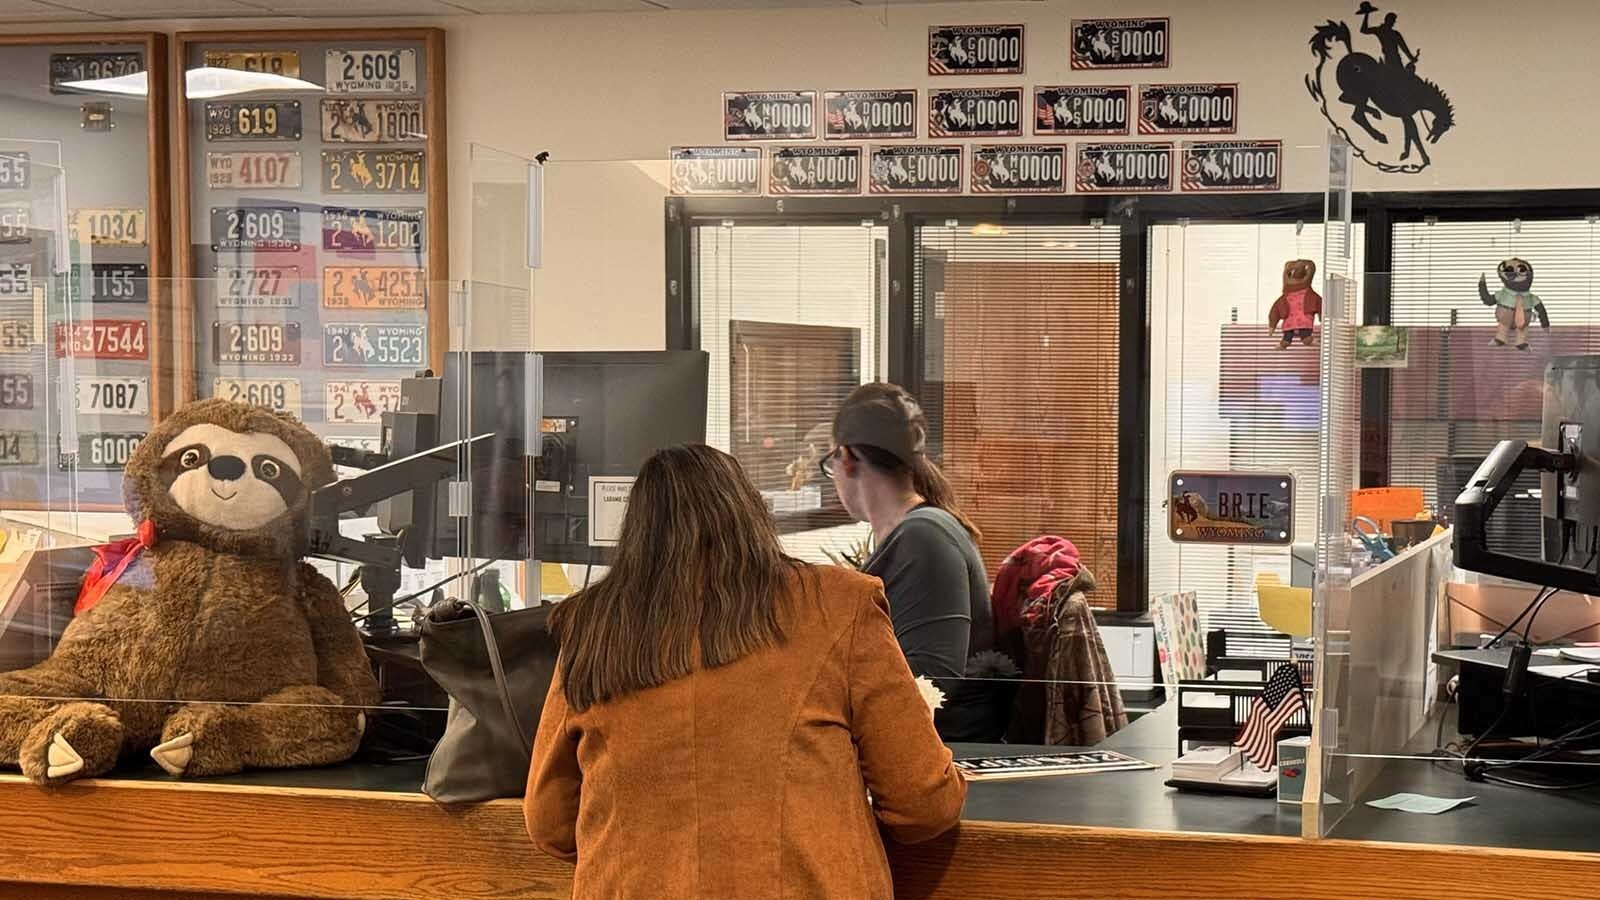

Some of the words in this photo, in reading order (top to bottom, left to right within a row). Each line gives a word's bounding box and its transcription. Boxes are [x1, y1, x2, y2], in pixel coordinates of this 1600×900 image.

[952, 27, 1001, 35] WYOMING
[1095, 20, 1146, 28] WYOMING
[335, 81, 382, 89] WYOMING
[952, 89, 1001, 97] WYOMING
[1057, 87, 1108, 95] WYOMING
[1163, 85, 1214, 93] WYOMING
[209, 109, 231, 119] WYO
[238, 108, 277, 134] 619
[331, 113, 341, 138] 2
[792, 147, 840, 155] WYOMING
[994, 145, 1043, 153] WYOMING
[240, 157, 289, 184] 4107
[331, 163, 341, 189] 2
[376, 163, 419, 189] 3714
[89, 214, 136, 239] 1034
[332, 221, 342, 247] 2
[377, 221, 420, 247] 1202
[220, 240, 264, 248] WYOMING
[333, 271, 343, 296] 2
[82, 326, 144, 352] 37544
[333, 336, 343, 362] 2
[378, 337, 421, 363] 5523
[91, 384, 138, 409] 7087
[334, 394, 344, 419] 2
[1218, 492, 1270, 518] BRIE
[1195, 527, 1265, 538] WYOMING
